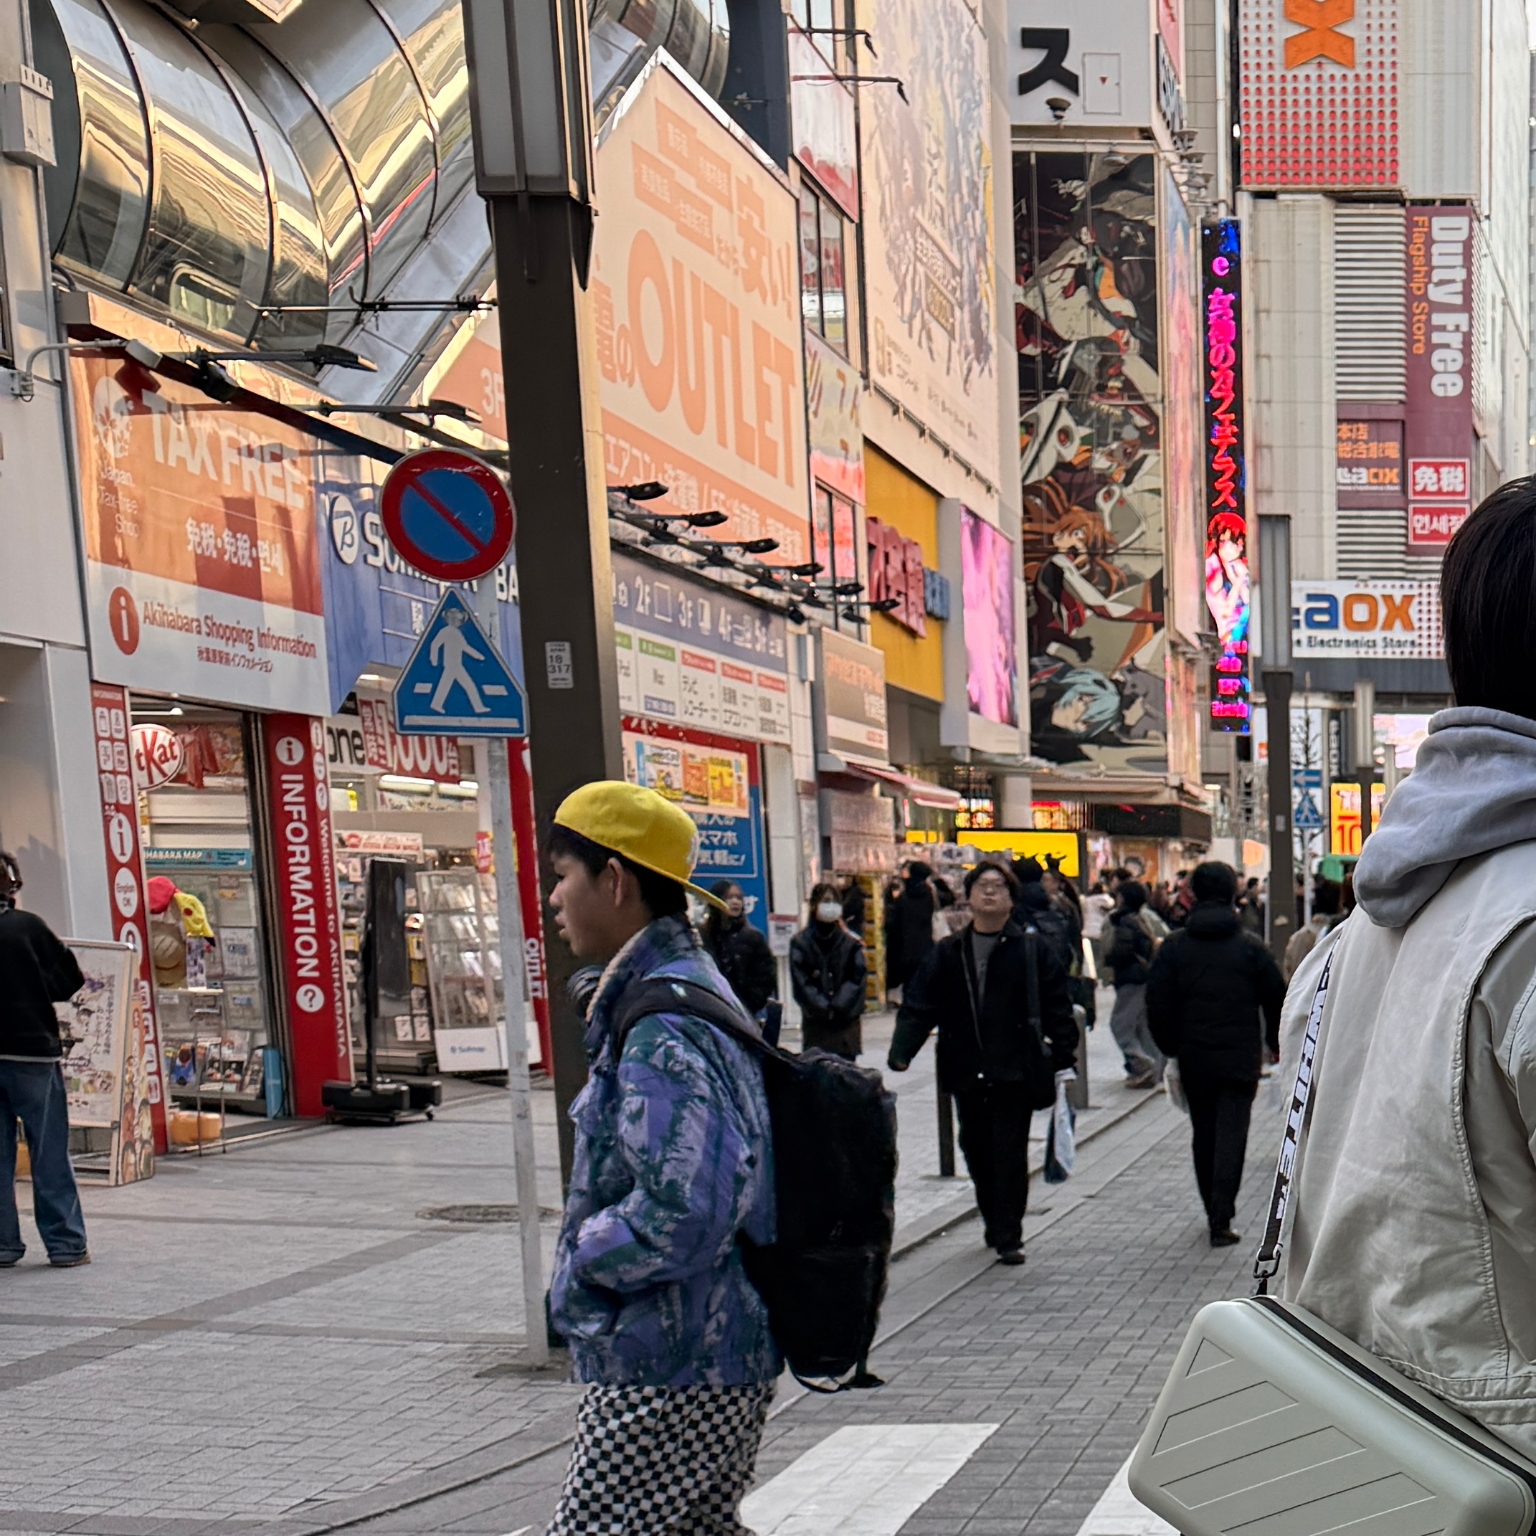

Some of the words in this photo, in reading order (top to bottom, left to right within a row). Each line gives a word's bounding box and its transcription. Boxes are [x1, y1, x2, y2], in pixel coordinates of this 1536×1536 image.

[1018, 27, 1079, 97] ス
[1408, 216, 1429, 296] Flagship
[1427, 216, 1469, 305] Duty
[627, 229, 797, 488] OUTLET
[1411, 301, 1429, 355] Store
[1430, 312, 1469, 397] Free
[142, 388, 218, 481] TAX
[218, 418, 305, 510] FREE
[1413, 465, 1465, 493] 免税
[143, 602, 202, 635] Akihabara
[203, 614, 255, 652] Shopping
[257, 627, 317, 659] Information
[549, 654, 565, 665] 18
[549, 664, 571, 675] 317
[1306, 635, 1377, 649] Electronics
[1381, 636, 1416, 649] Store
[281, 773, 320, 978] INFORMATION
[320, 818, 333, 910] Welcome
[327, 913, 335, 933] to
[329, 936, 346, 1059] AKIHABARA
[1279, 988, 1328, 1175] WHITE
